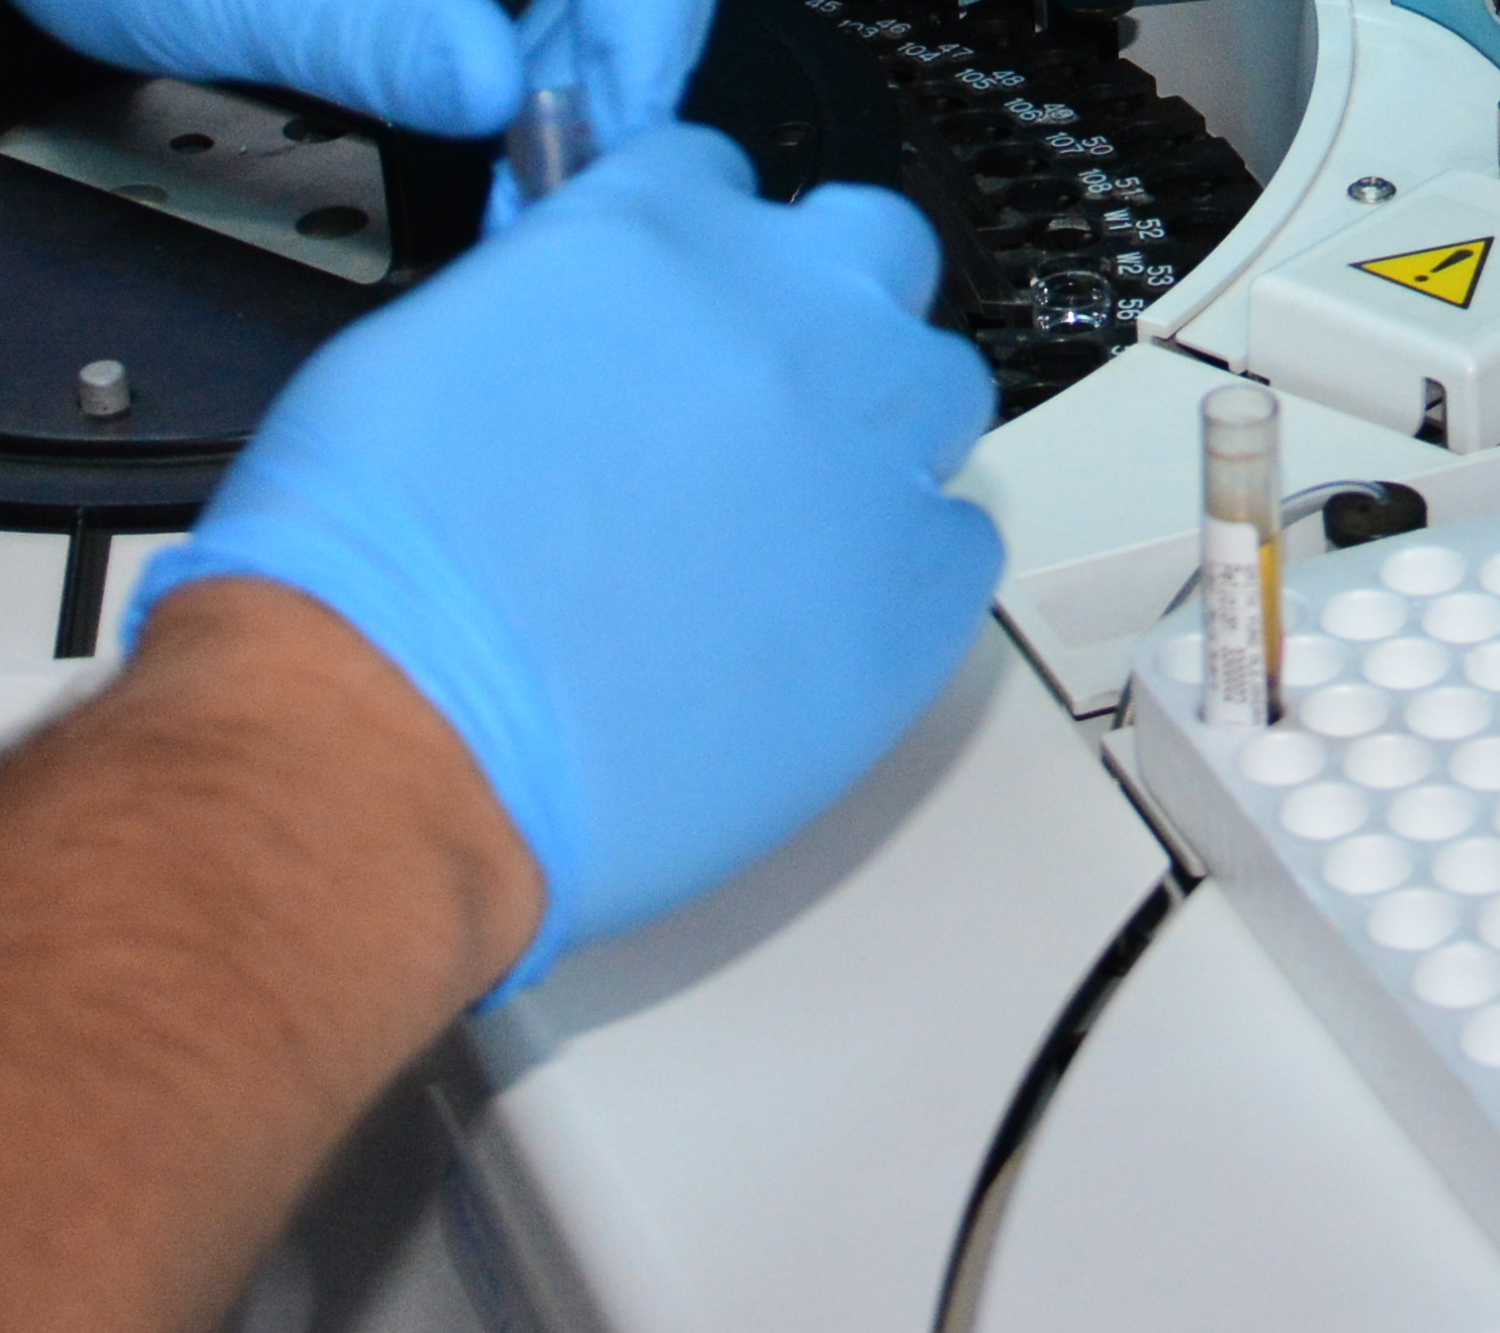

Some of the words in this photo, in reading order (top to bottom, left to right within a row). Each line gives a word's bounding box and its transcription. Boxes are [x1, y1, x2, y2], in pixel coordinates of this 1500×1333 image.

[875, 18, 912, 35] 46
[897, 41, 942, 63] 104
[938, 43, 975, 59] 47
[954, 67, 999, 91] 105
[991, 69, 1026, 87] 48
[1003, 97, 1044, 122] 106
[1045, 131, 1085, 155] 107
[1082, 134, 1115, 156] 50
[1078, 168, 1113, 194] 108
[1115, 176, 1145, 196] 51
[1103, 207, 1133, 231] W1
[1136, 218, 1166, 240] 52
[1116, 251, 1144, 275] W2
[1147, 264, 1175, 287] 53
[1116, 298, 1145, 321] 56
